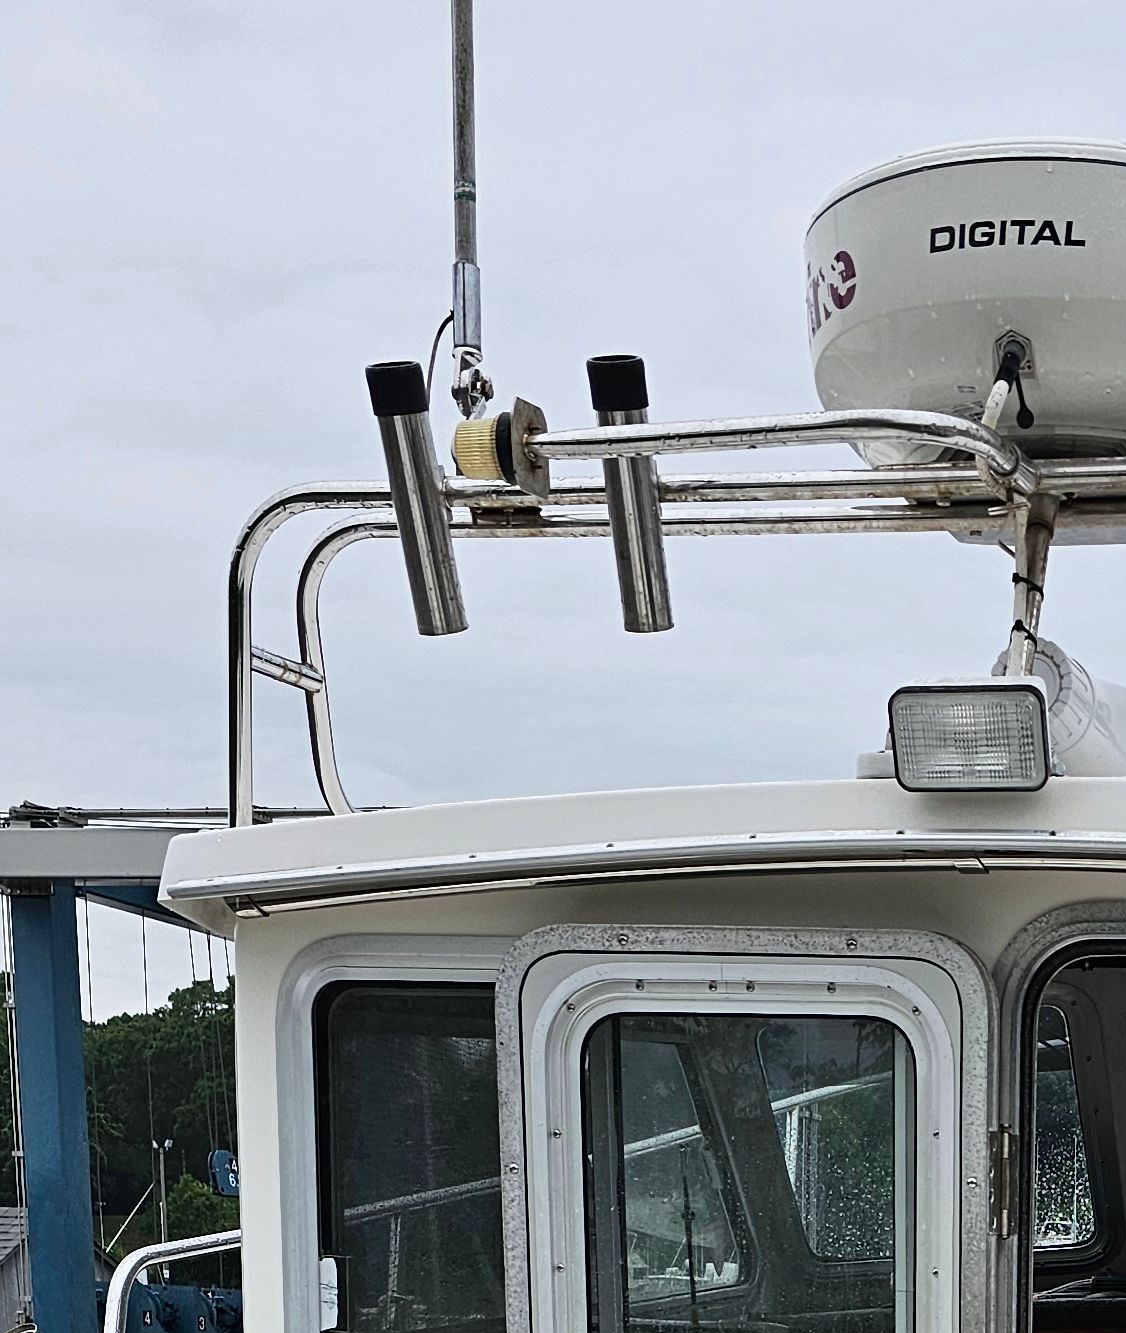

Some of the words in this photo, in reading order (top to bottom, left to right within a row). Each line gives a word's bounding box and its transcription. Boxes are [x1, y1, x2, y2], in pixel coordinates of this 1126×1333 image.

[929, 219, 1087, 254] DIGITAL
[144, 1311, 151, 1325] 4
[198, 1316, 205, 1331] 3
